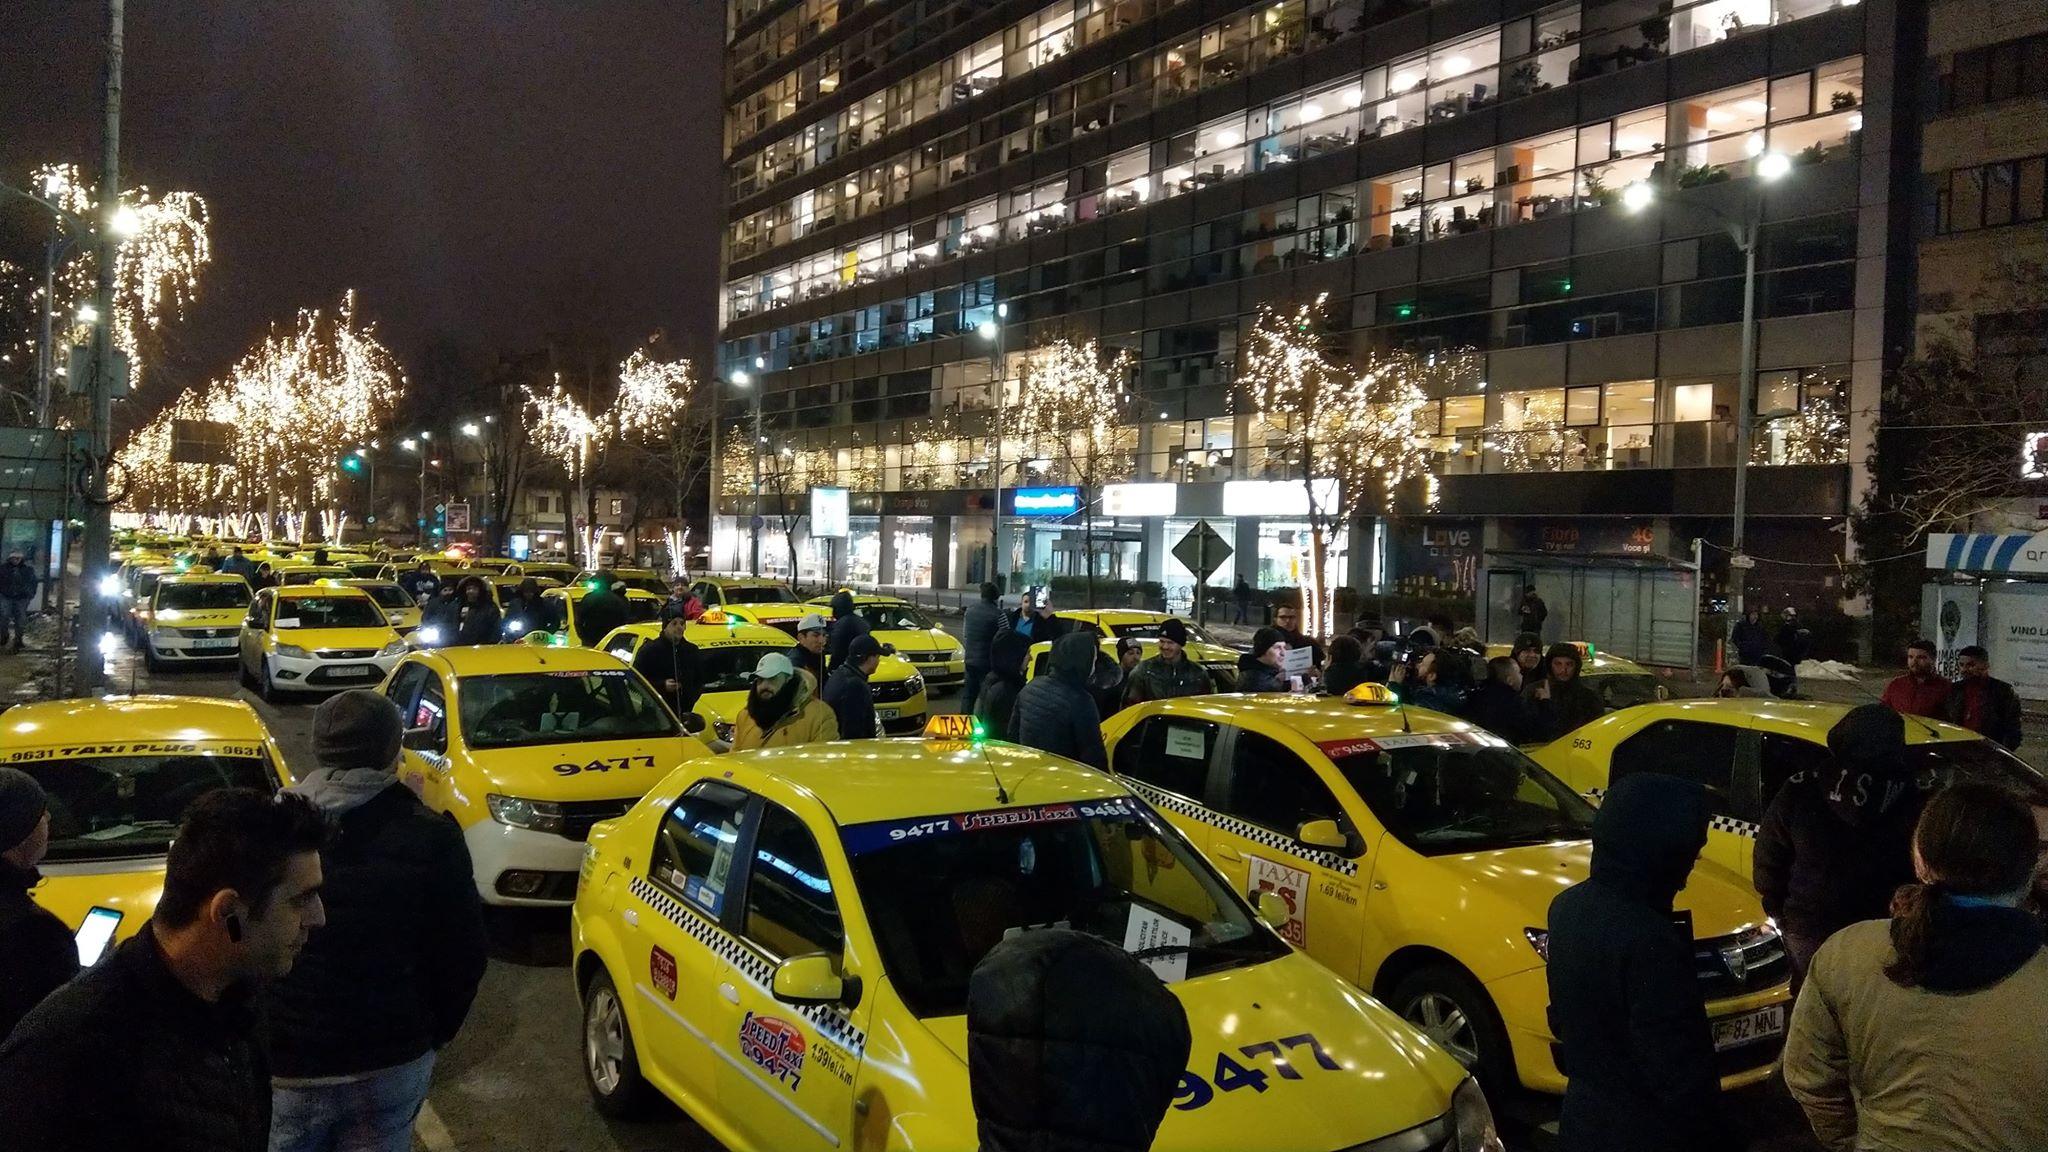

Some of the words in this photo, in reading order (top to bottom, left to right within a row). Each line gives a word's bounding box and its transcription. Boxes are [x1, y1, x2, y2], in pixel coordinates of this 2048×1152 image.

[1422, 525, 1471, 547] Love
[1631, 527, 1654, 542] 4G
[2010, 625, 2038, 636] VINO
[940, 716, 973, 736] TAXI
[11, 750, 54, 763] 9631
[60, 746, 126, 757] TAXI
[131, 744, 197, 753] PLUS
[222, 745, 263, 757] 9631
[1343, 742, 1375, 755] 9435
[1572, 736, 1593, 751] 563
[552, 755, 656, 777] 9477
[889, 820, 950, 840] 9477
[1080, 804, 1132, 818] 9488
[1256, 859, 1304, 888] TAXI
[751, 1045, 802, 1093] 9477
[1173, 1032, 1343, 1111] 9477
